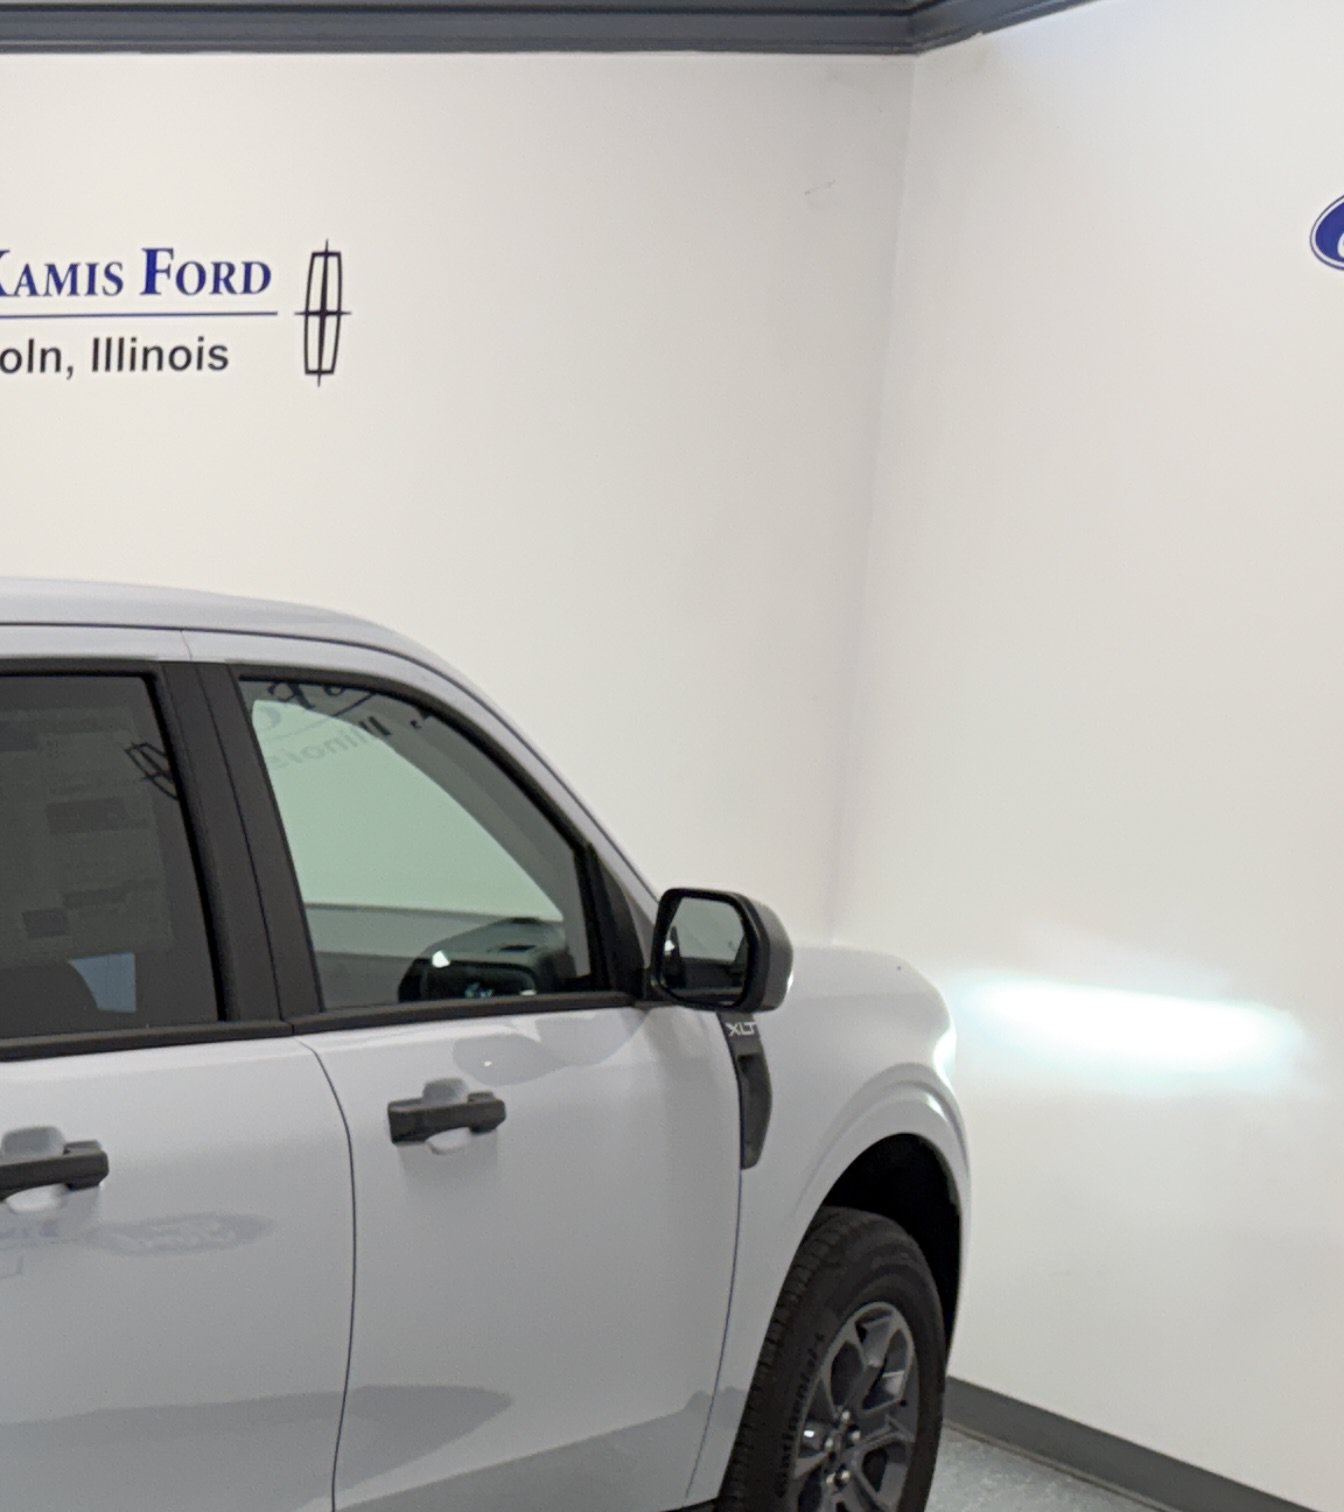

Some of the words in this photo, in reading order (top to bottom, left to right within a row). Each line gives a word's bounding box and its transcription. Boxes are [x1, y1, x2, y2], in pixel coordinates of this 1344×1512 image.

[139, 247, 272, 297] FORD
[91, 335, 229, 373] Illinois
[725, 1021, 758, 1037] XLT
